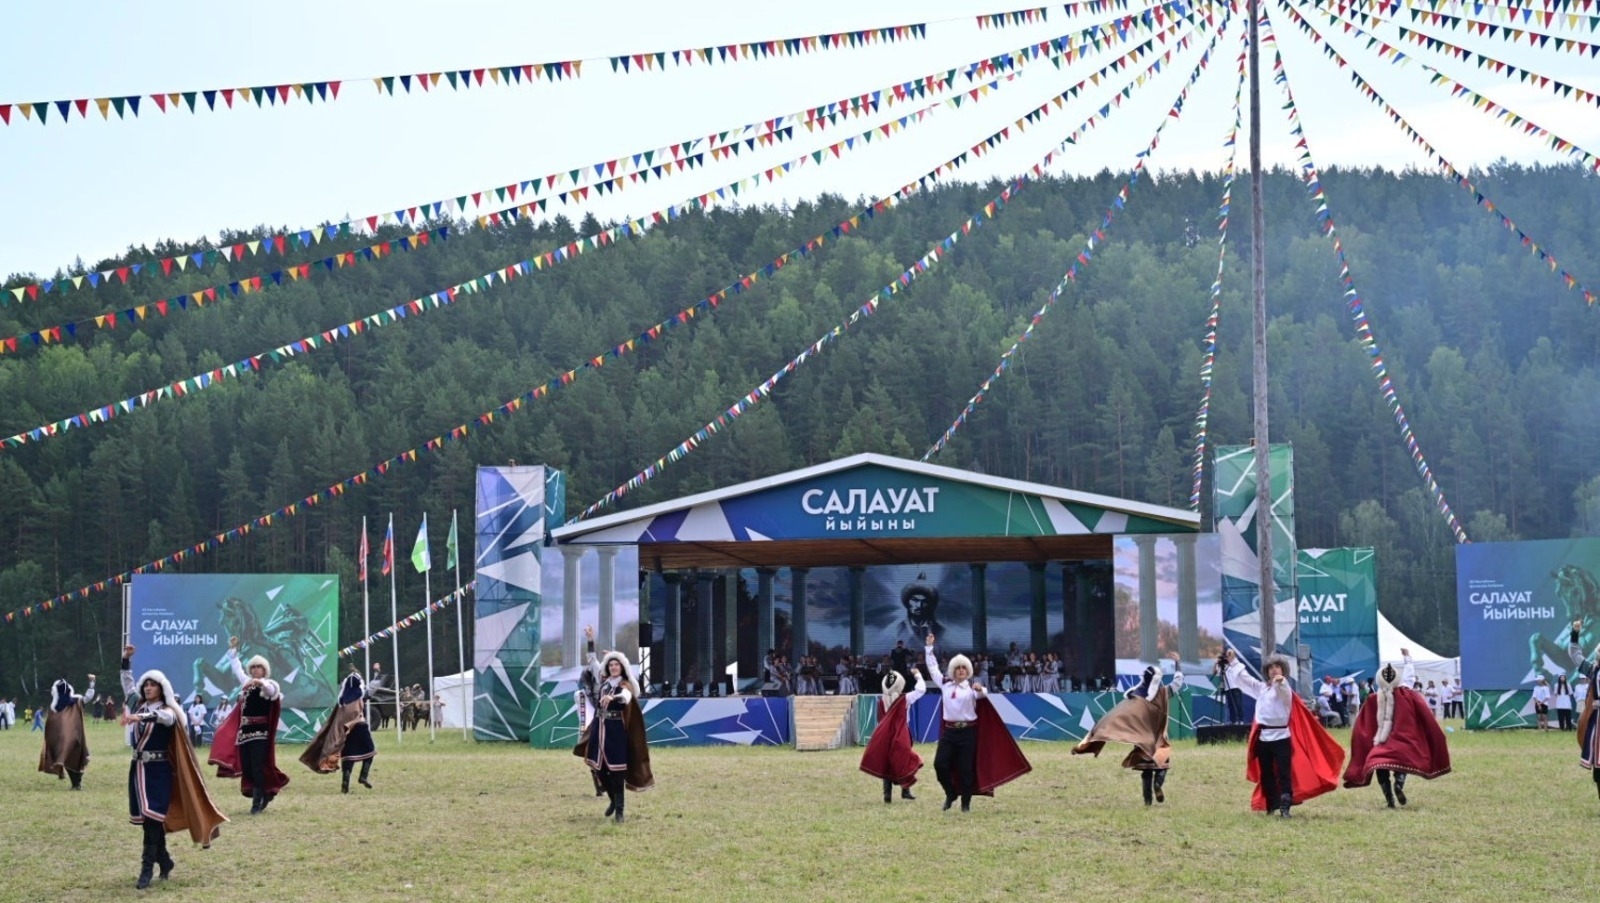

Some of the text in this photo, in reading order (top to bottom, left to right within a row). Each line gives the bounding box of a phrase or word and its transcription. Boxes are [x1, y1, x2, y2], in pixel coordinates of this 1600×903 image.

[801, 487, 940, 515] САЛАУАТ
[826, 516, 915, 531] ЙЫЙЫНЫ
[1298, 593, 1347, 613] АУАТ
[1469, 591, 1533, 605] САЛАУАТ
[1300, 615, 1332, 624] ЫНЫ
[1483, 604, 1555, 620] ЙЫЙЫНЫ
[141, 619, 199, 631] САЛАУАТ
[153, 631, 218, 646] ЙЫЙЫНЫ
